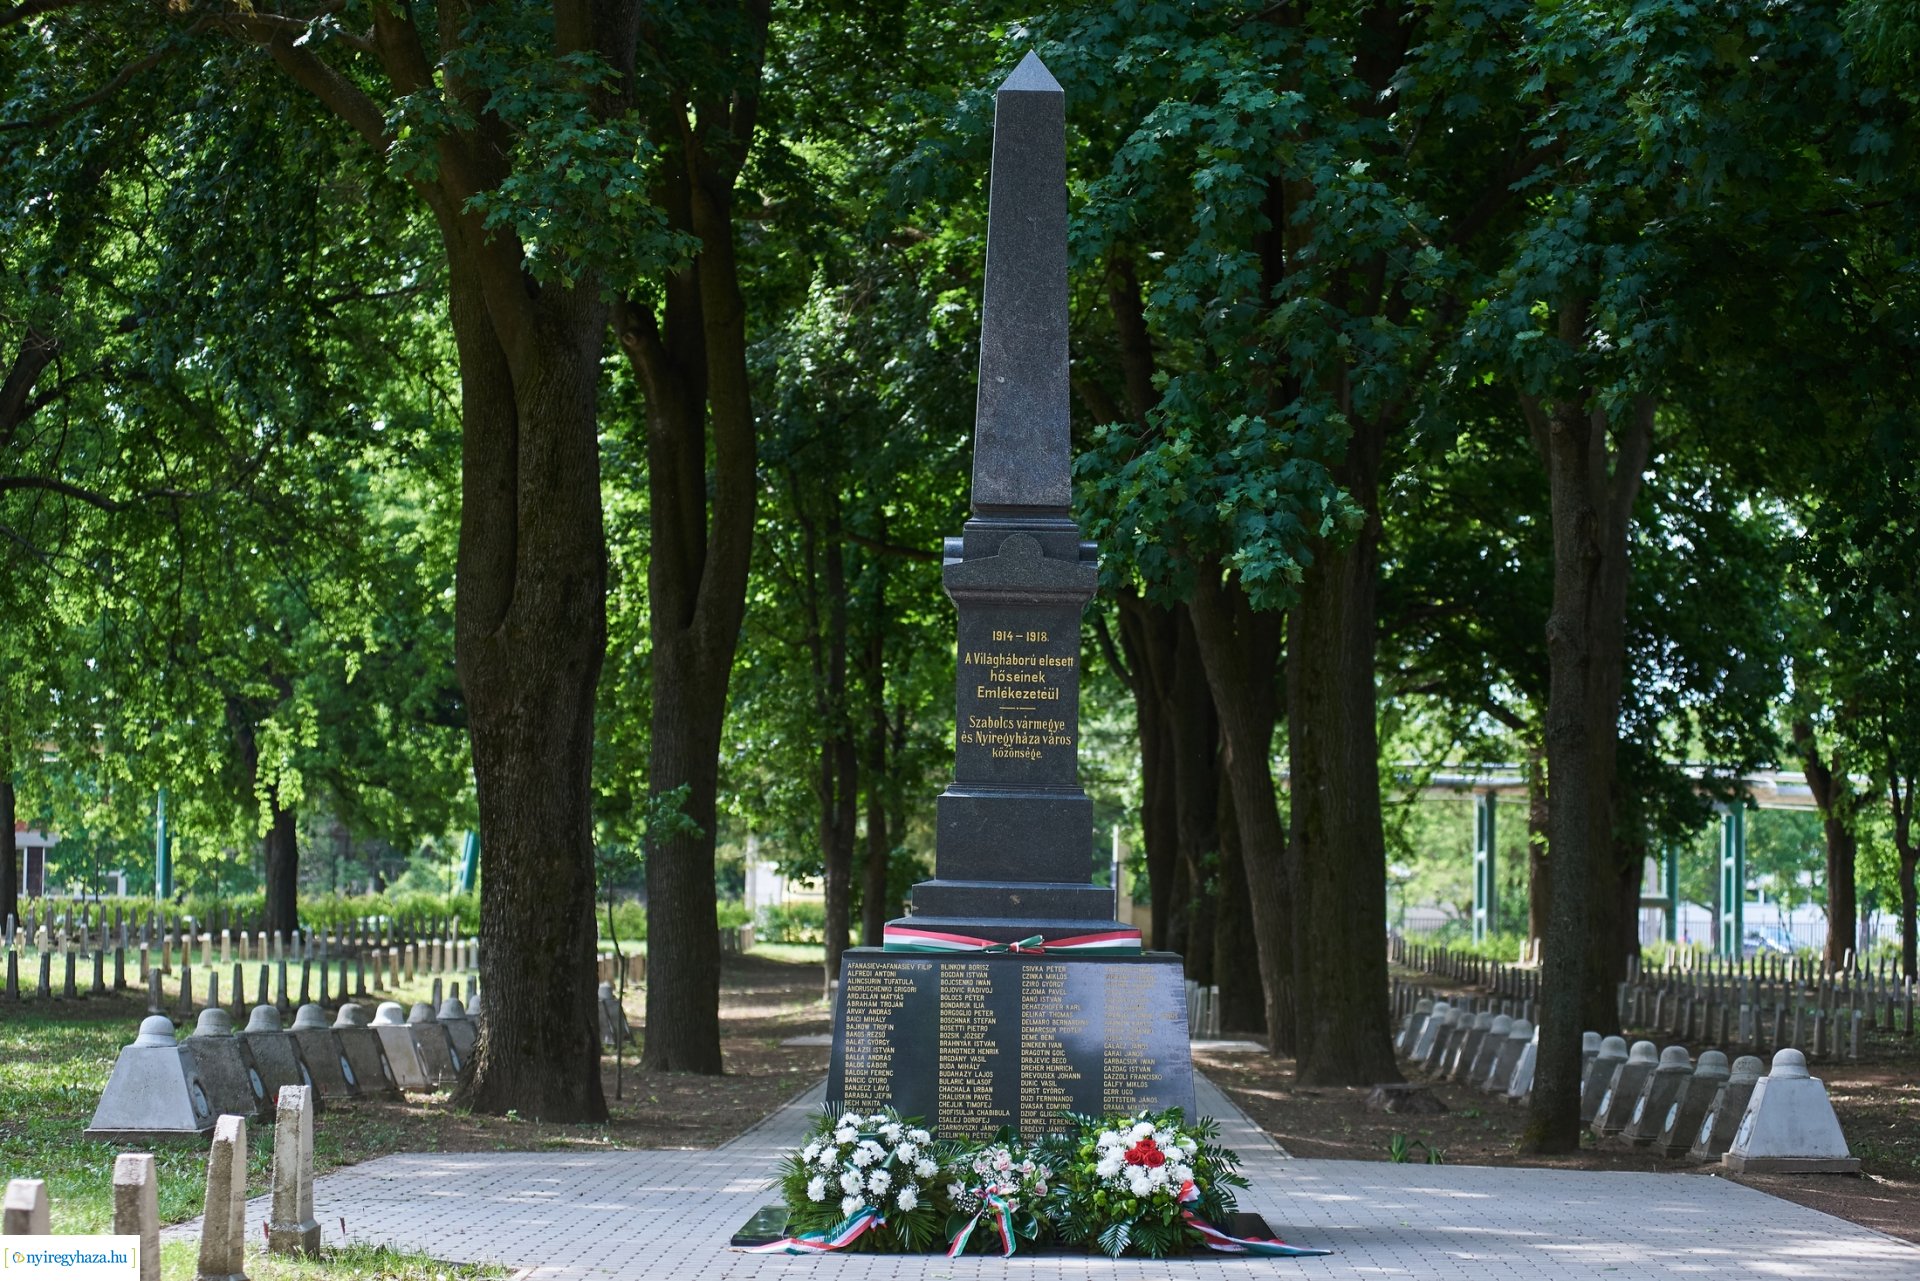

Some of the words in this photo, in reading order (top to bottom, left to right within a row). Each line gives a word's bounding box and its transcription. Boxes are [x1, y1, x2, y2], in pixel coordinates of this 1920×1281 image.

[992, 630, 1013, 642] 1914
[965, 652, 972, 664] A
[974, 652, 1036, 668] Világháború
[1039, 654, 1074, 667] elesett
[990, 669, 1045, 683] hőseinek
[969, 715, 1014, 728] Szabolcs
[1016, 716, 1065, 732] vármegye
[961, 731, 973, 743] és
[1043, 733, 1071, 745] város
